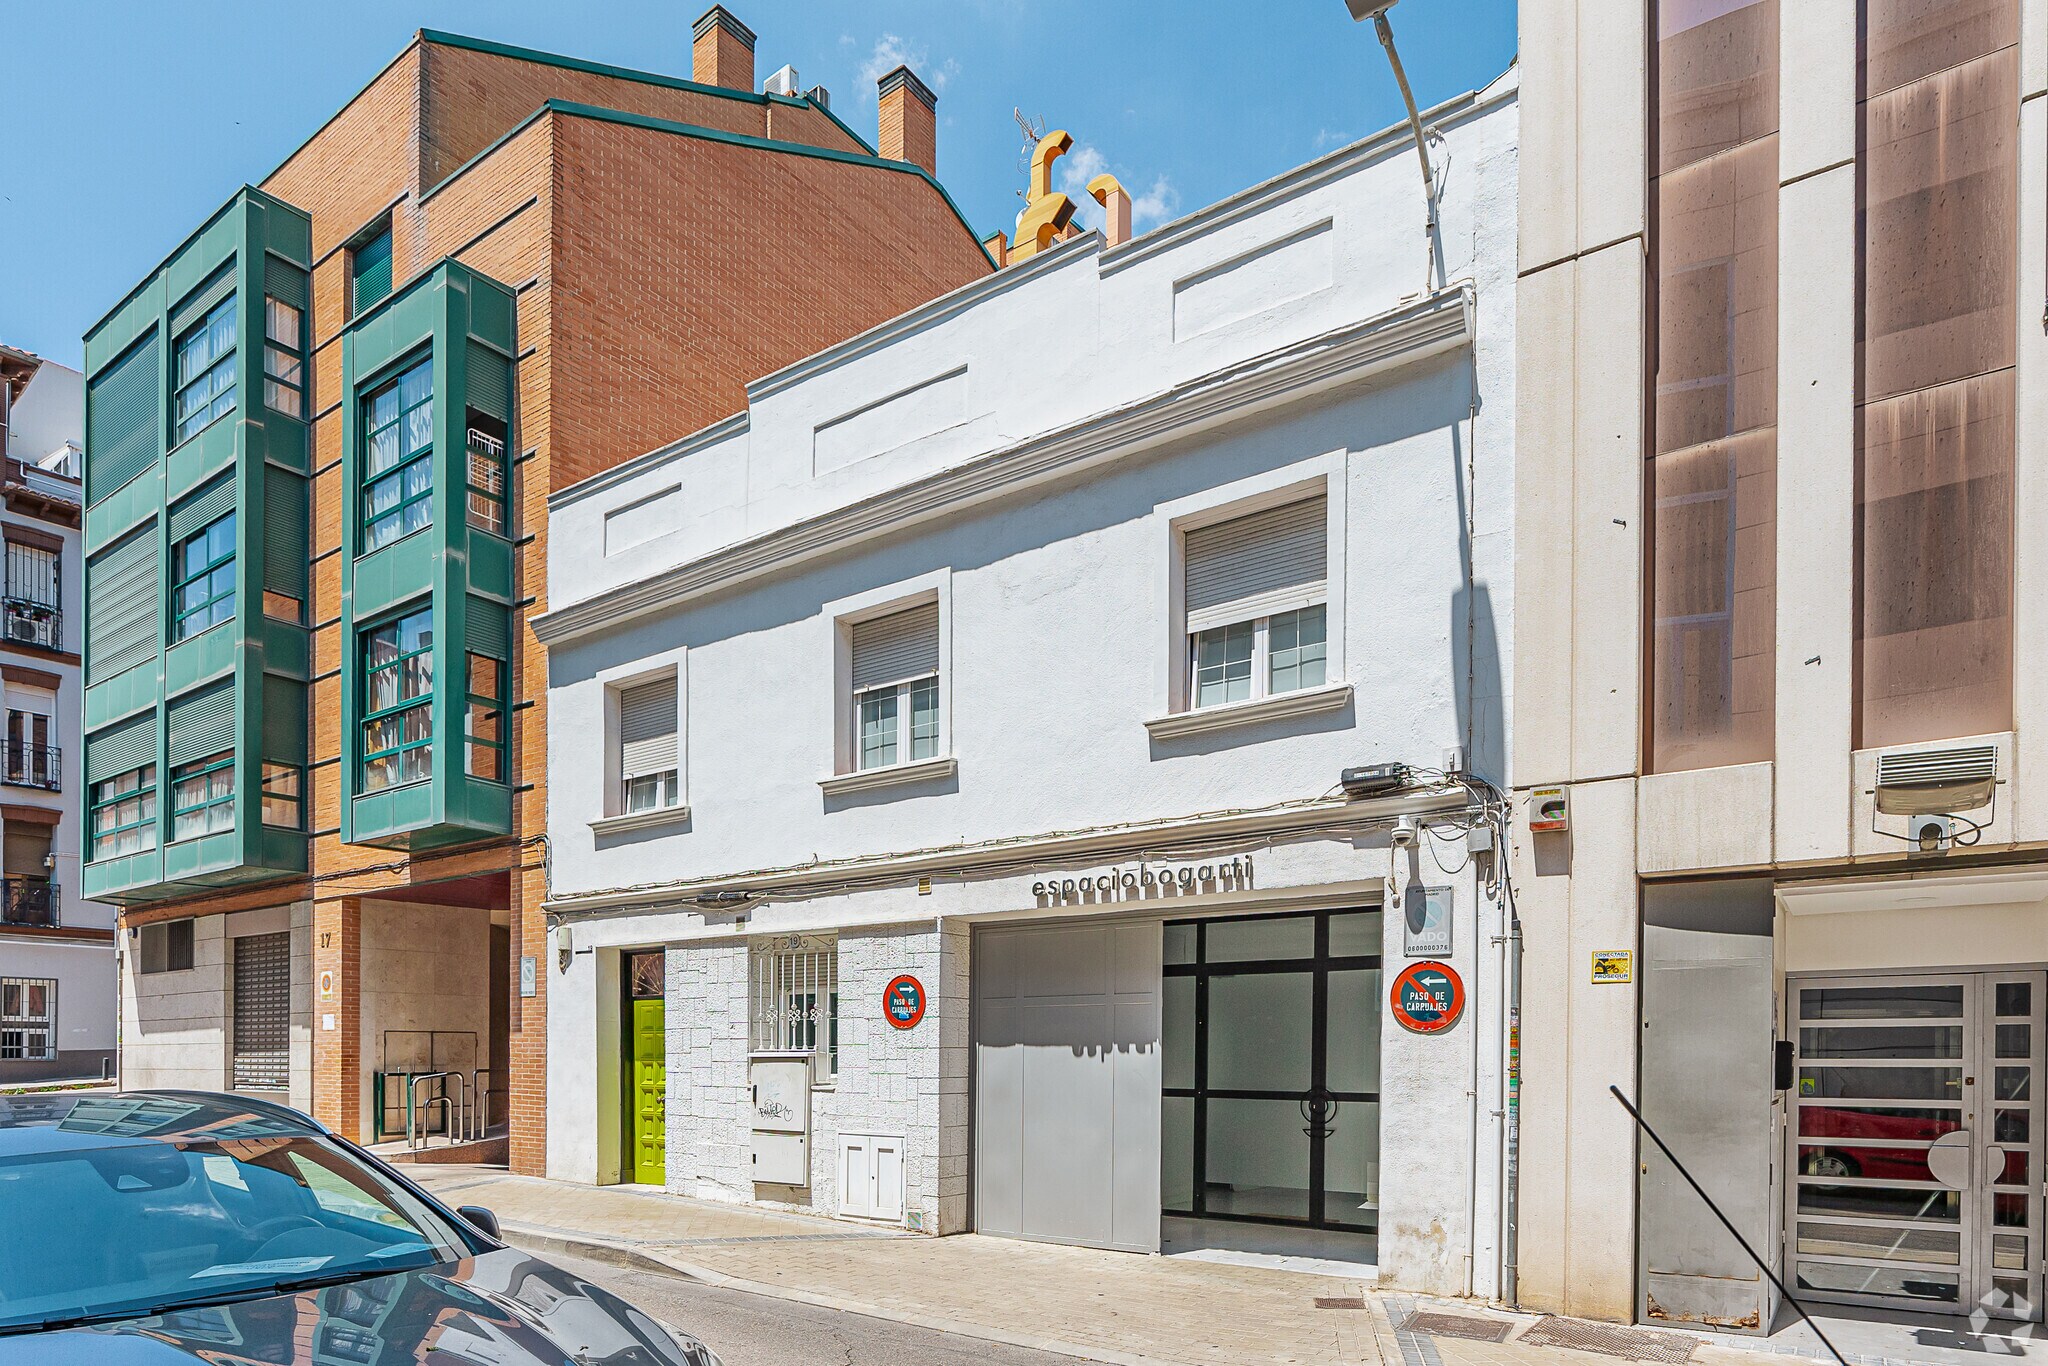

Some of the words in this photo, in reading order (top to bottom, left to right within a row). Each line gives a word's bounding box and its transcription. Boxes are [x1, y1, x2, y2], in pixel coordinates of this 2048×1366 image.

[1031, 854, 1253, 900] espaciobogarti
[320, 932, 331, 948] 17
[790, 936, 798, 945] 19
[1409, 931, 1447, 942] VADO
[1409, 991, 1429, 1001] PASO
[1435, 991, 1445, 1001] DE
[1406, 1002, 1448, 1011] CARRUAJES
